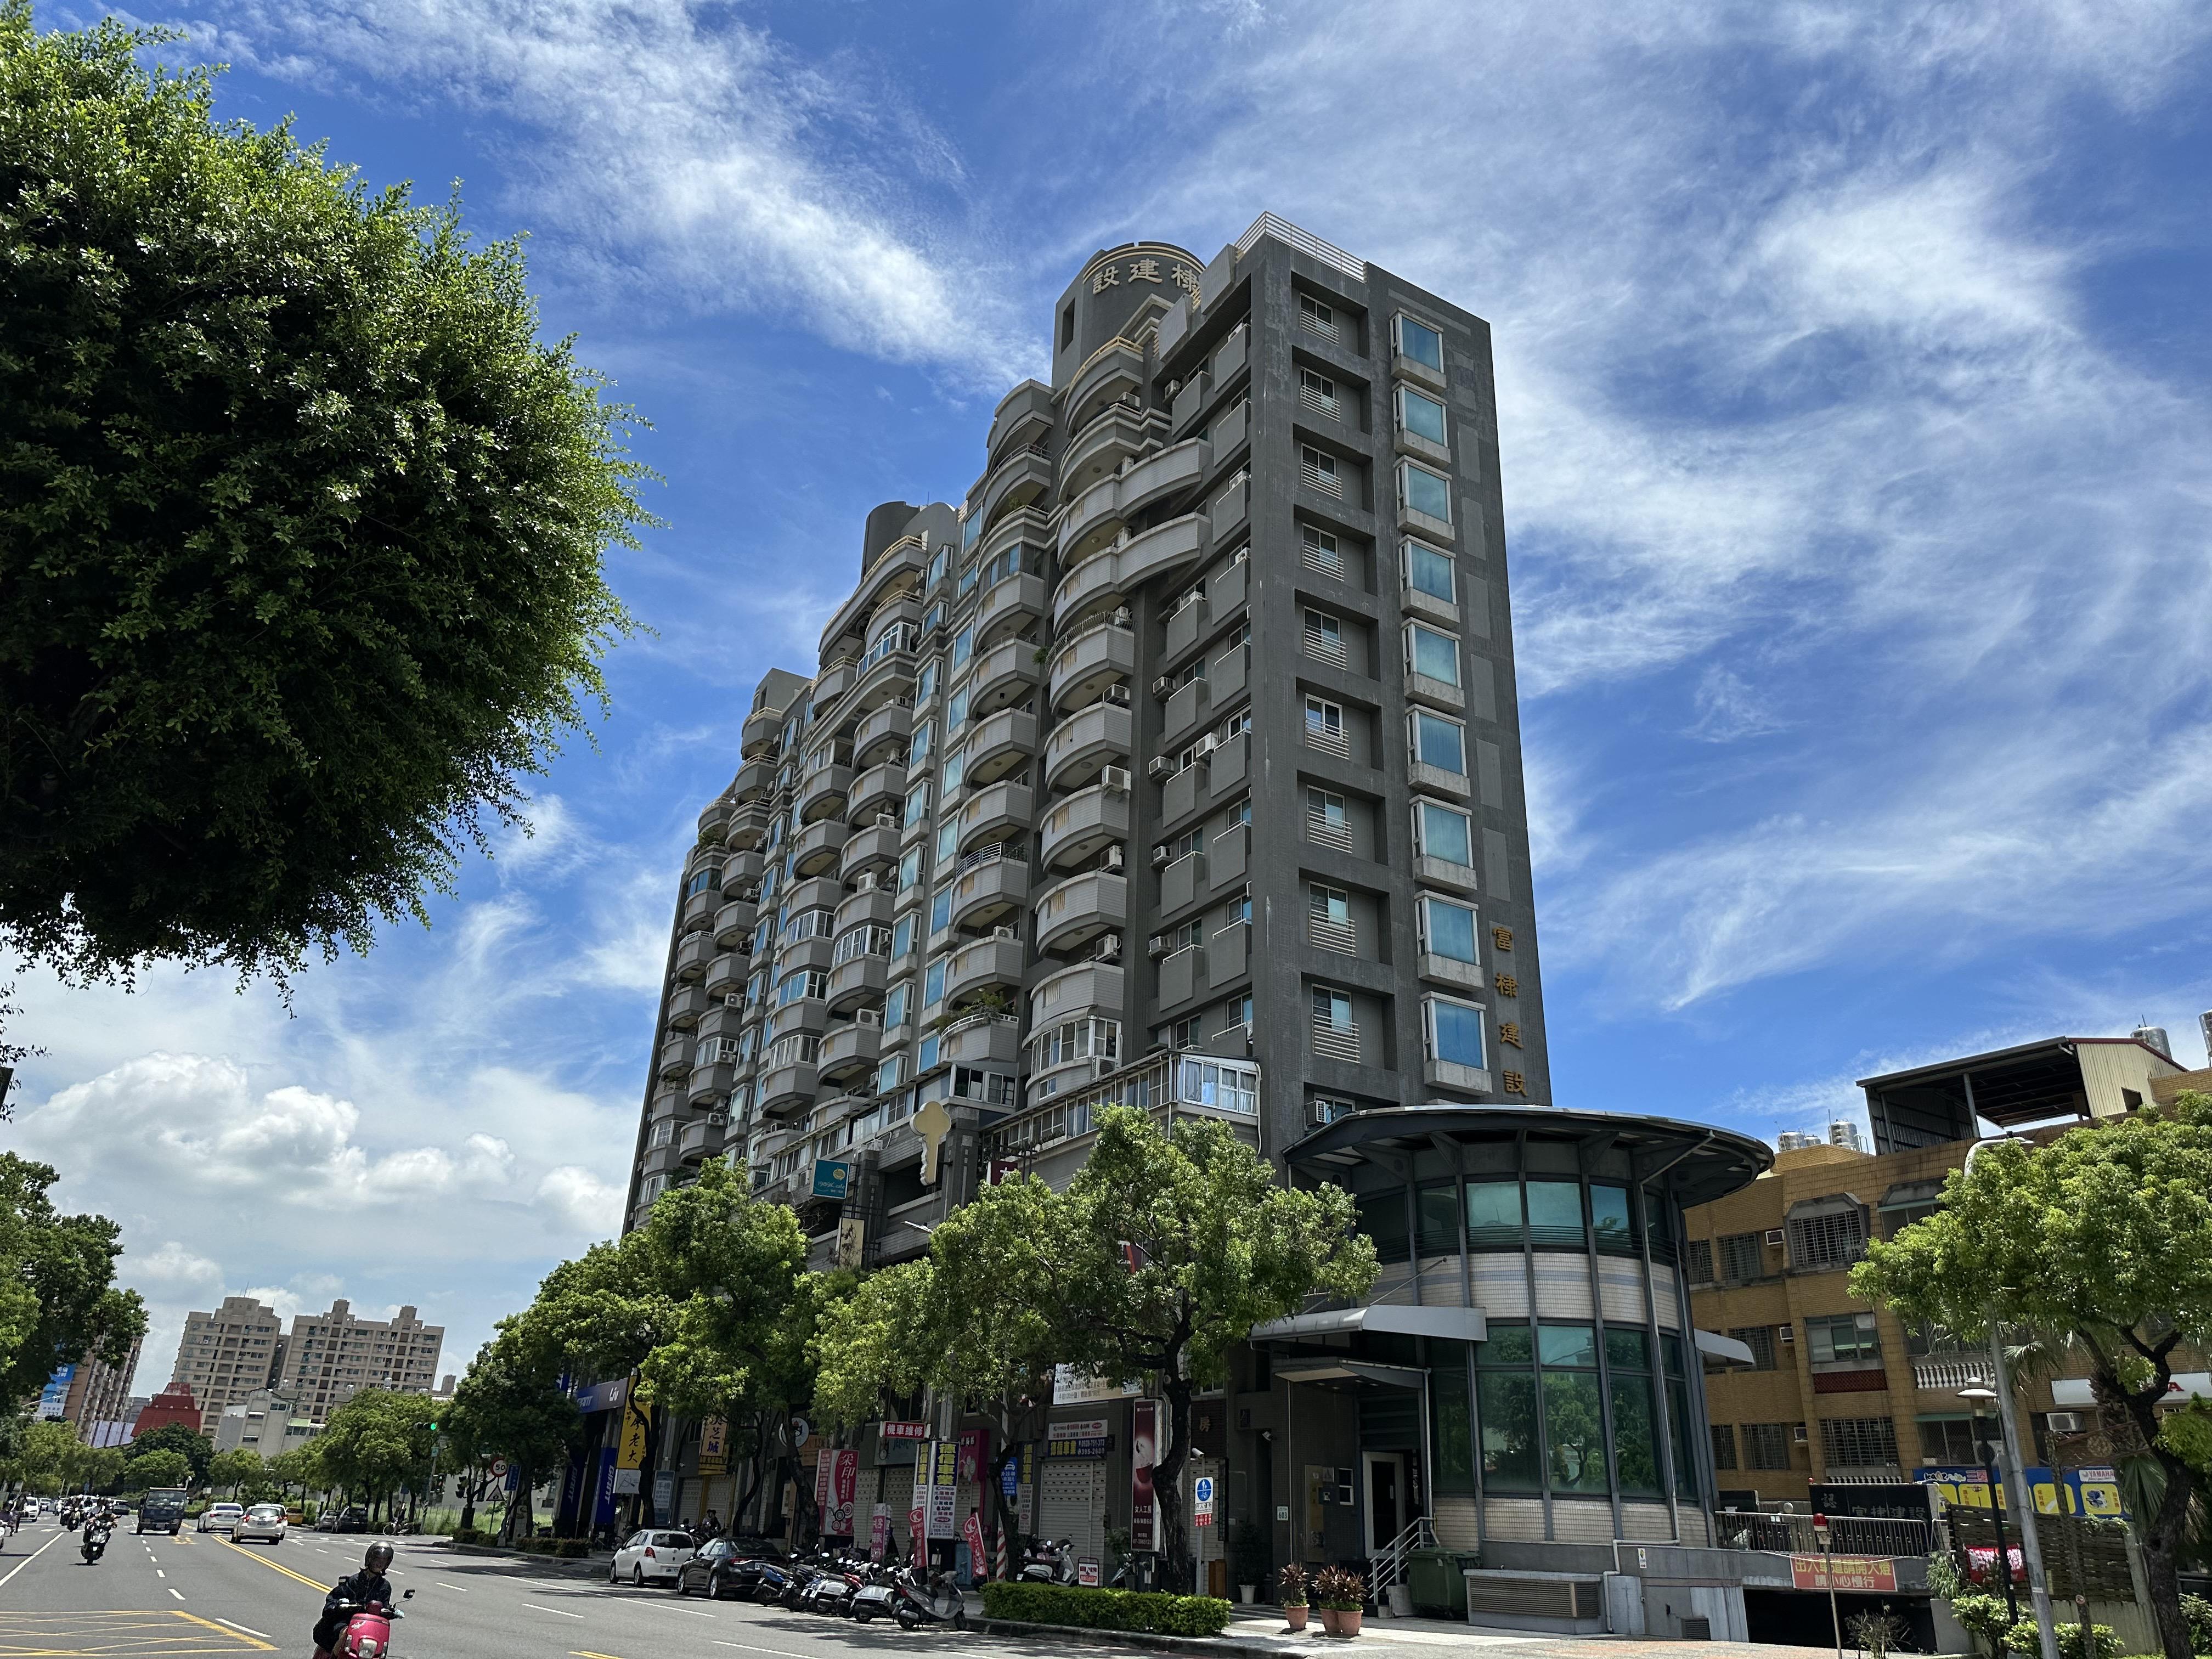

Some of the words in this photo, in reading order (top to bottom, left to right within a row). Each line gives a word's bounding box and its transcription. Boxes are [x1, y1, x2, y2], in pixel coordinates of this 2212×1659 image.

[1492, 926, 1527, 1097] 富棣建設
[609, 1387, 619, 1402] Liv
[887, 1424, 923, 1436] 機車維修
[605, 1465, 615, 1505] GIANT
[1795, 1557, 1892, 1576] 出入車道請開大燈
[1815, 1574, 1875, 1588] 請小心慢行
